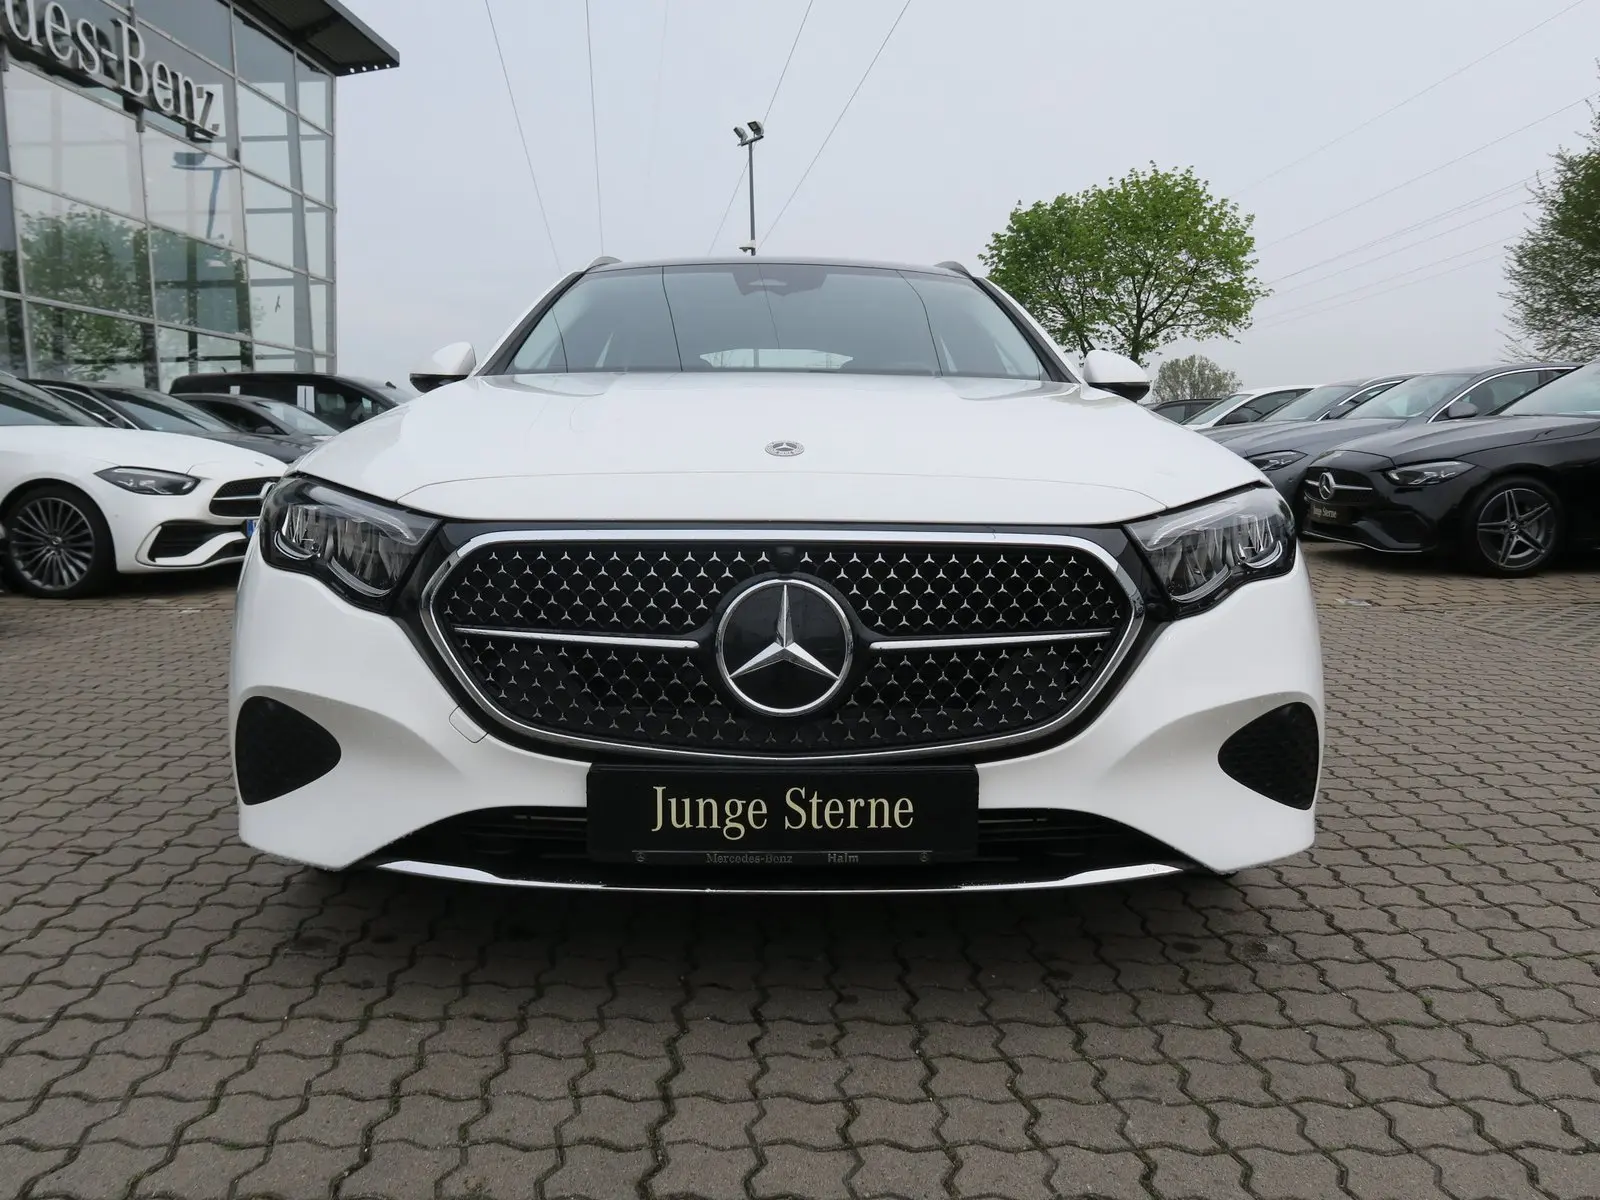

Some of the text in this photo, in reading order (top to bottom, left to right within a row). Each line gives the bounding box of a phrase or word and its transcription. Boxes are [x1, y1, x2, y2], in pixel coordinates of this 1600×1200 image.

[651, 786, 914, 841] Junge Sterne
[706, 852, 859, 864] Mercedes-Benz Halm
